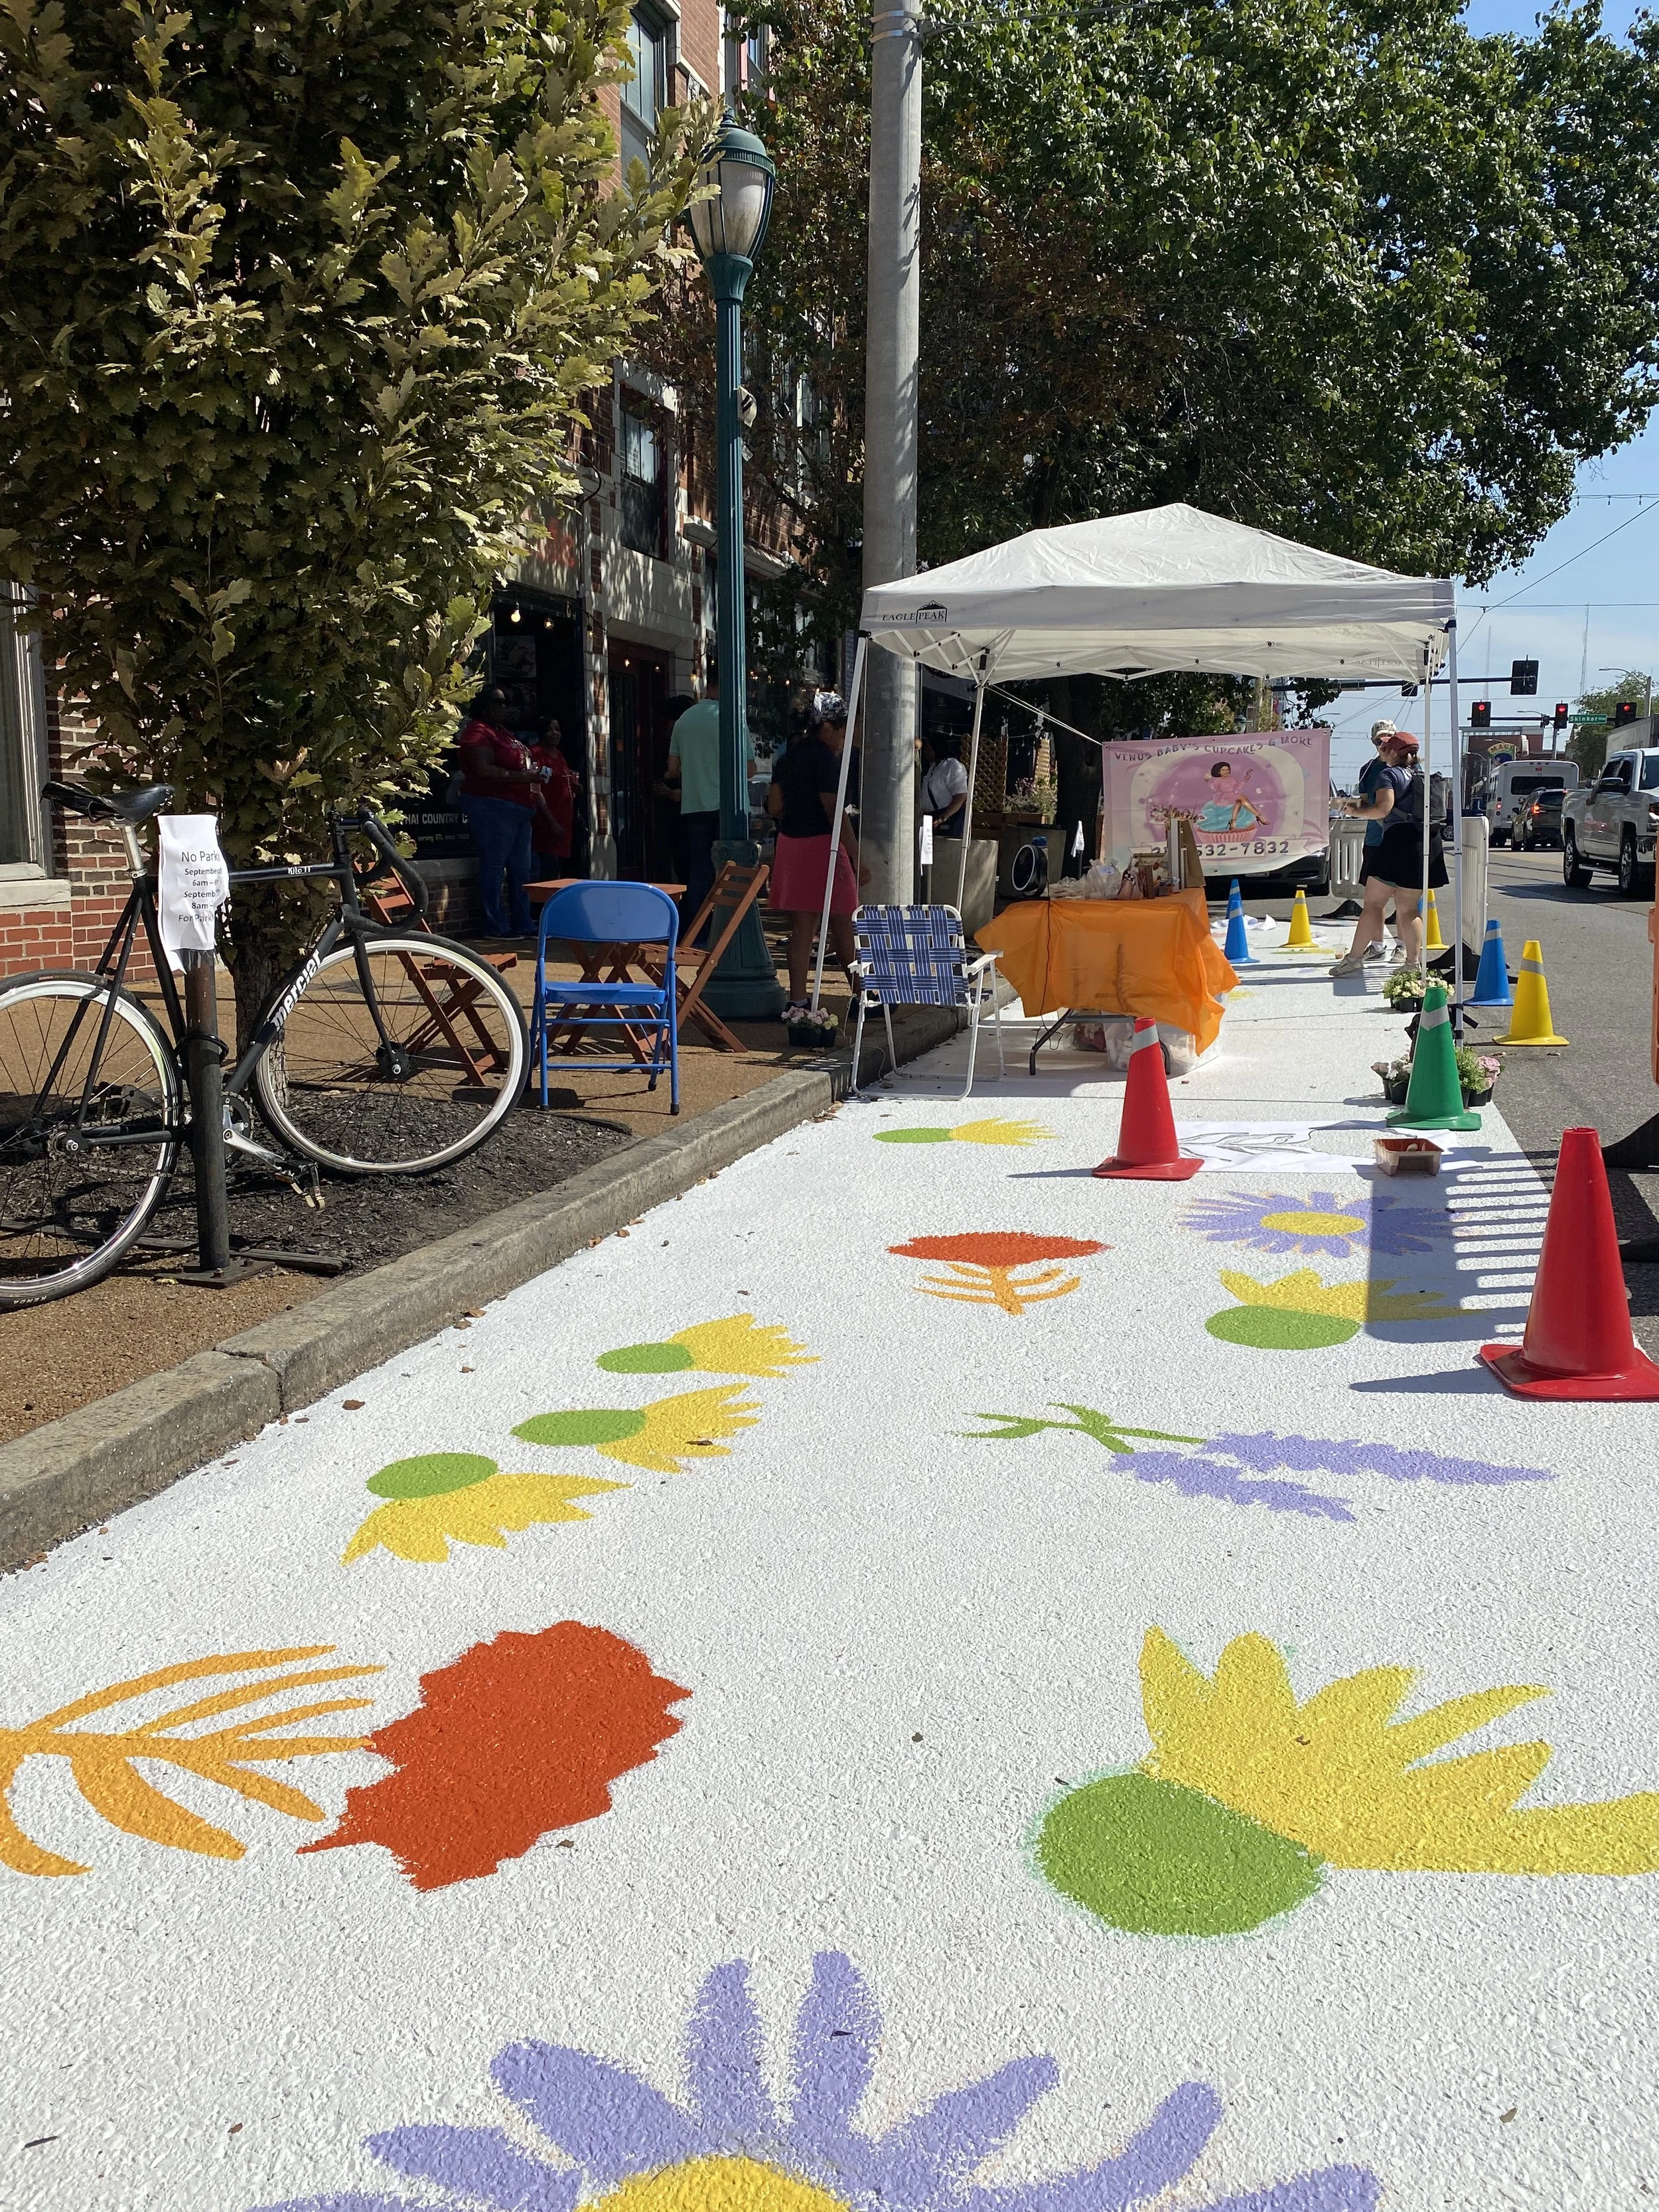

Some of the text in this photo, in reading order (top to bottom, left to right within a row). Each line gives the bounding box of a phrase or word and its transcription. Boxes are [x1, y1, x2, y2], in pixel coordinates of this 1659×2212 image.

[883, 611, 945, 621] EAGLE PEAK
[1114, 752, 1152, 761] VENUS
[1157, 743, 1198, 757] BABY'S
[1204, 743, 1263, 755] CUPCAKES
[1281, 736, 1313, 748] MORE
[403, 814, 419, 825] HAI
[421, 813, 459, 824] COUNTRY
[181, 851, 197, 862] No
[270, 948, 321, 1032] mercier
